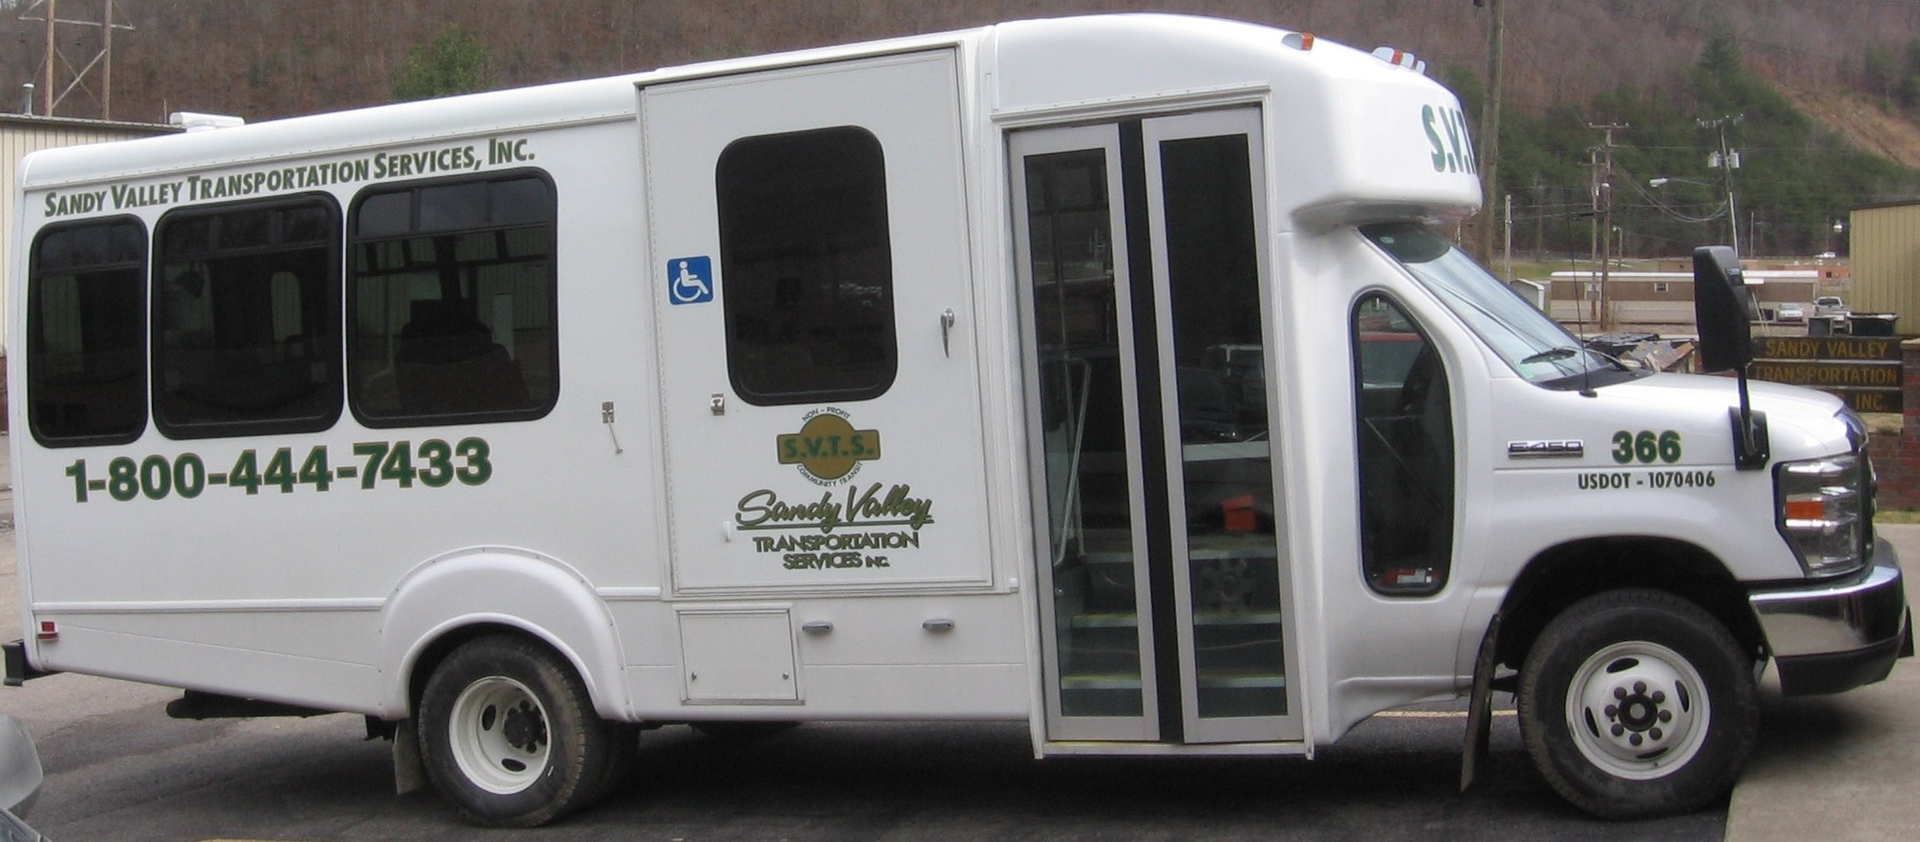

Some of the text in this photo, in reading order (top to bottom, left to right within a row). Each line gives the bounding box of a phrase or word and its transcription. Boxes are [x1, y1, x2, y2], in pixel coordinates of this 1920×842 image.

[44, 137, 535, 217] SANDY VALLEY TRANSPORTATION SERVICES, INC.
[1766, 339, 1888, 358] SANDY VALLEY
[1754, 366, 1898, 385] TRANSPORTATION
[802, 408, 819, 422] NON
[827, 406, 851, 419] PROFIT
[784, 434, 874, 459] S.V.T.S.
[1612, 430, 1682, 464] 366
[65, 436, 492, 503] 1-800-444-7433
[796, 464, 837, 487] COMMUNITY
[1578, 473, 1631, 490] USDOT
[1648, 471, 1716, 489] 1070406
[735, 482, 934, 534] Sandy Valley
[753, 531, 920, 553] TRANSPORTATION
[783, 551, 863, 570] SERVICES
